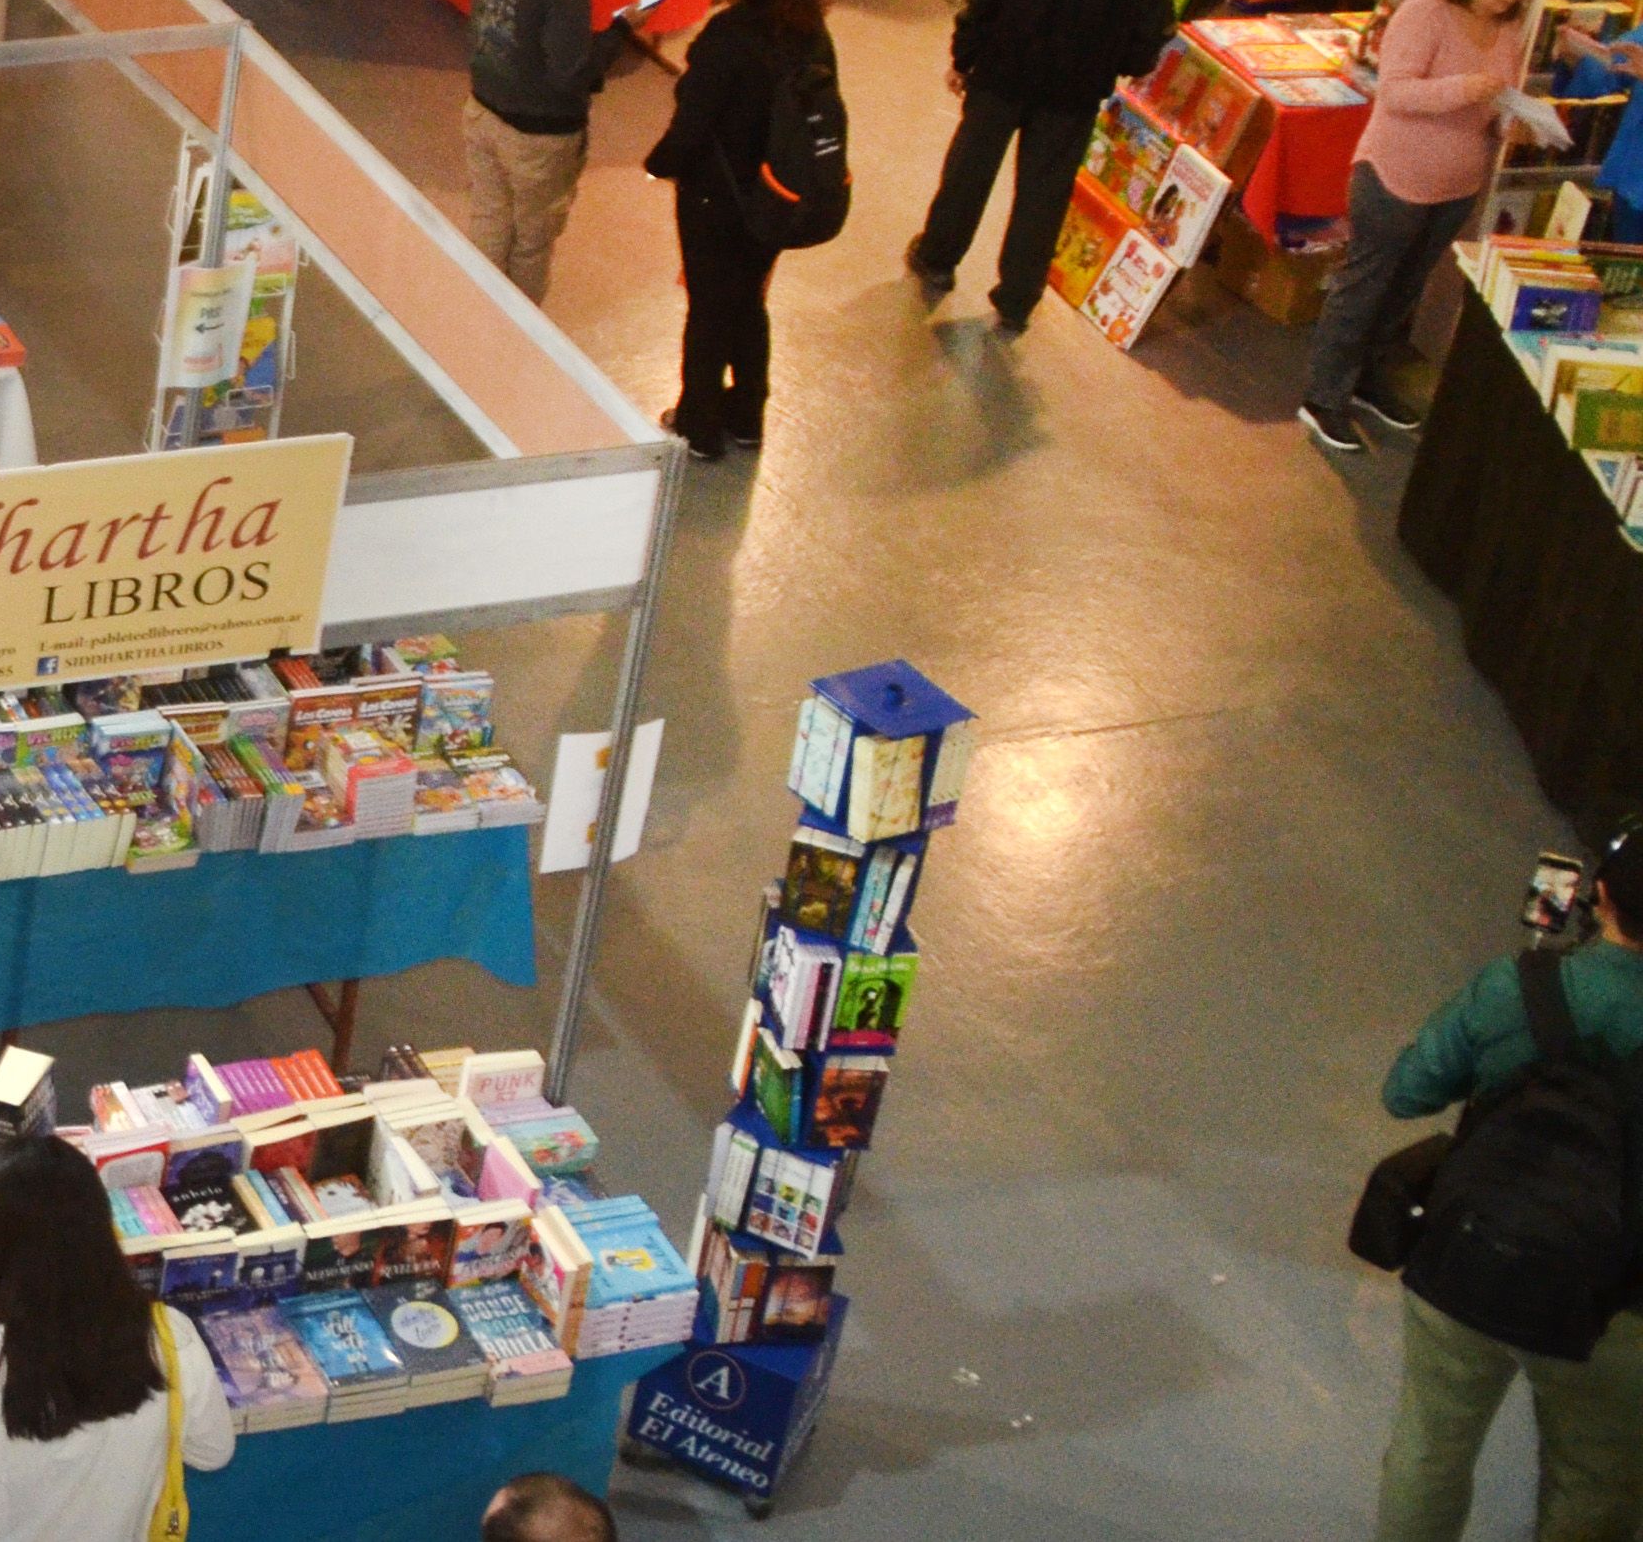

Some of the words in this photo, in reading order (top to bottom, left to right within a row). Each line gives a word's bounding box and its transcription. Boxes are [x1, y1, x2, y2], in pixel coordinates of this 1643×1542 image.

[40, 561, 270, 625] LIBROS
[65, 648, 165, 668] SIDDHARTHA
[169, 641, 223, 657] LIBROS
[479, 1071, 537, 1094] PUNK
[696, 1365, 731, 1401] A
[648, 1392, 776, 1462] Editorial
[638, 1417, 675, 1442] El
[677, 1435, 770, 1488] Ateneo
